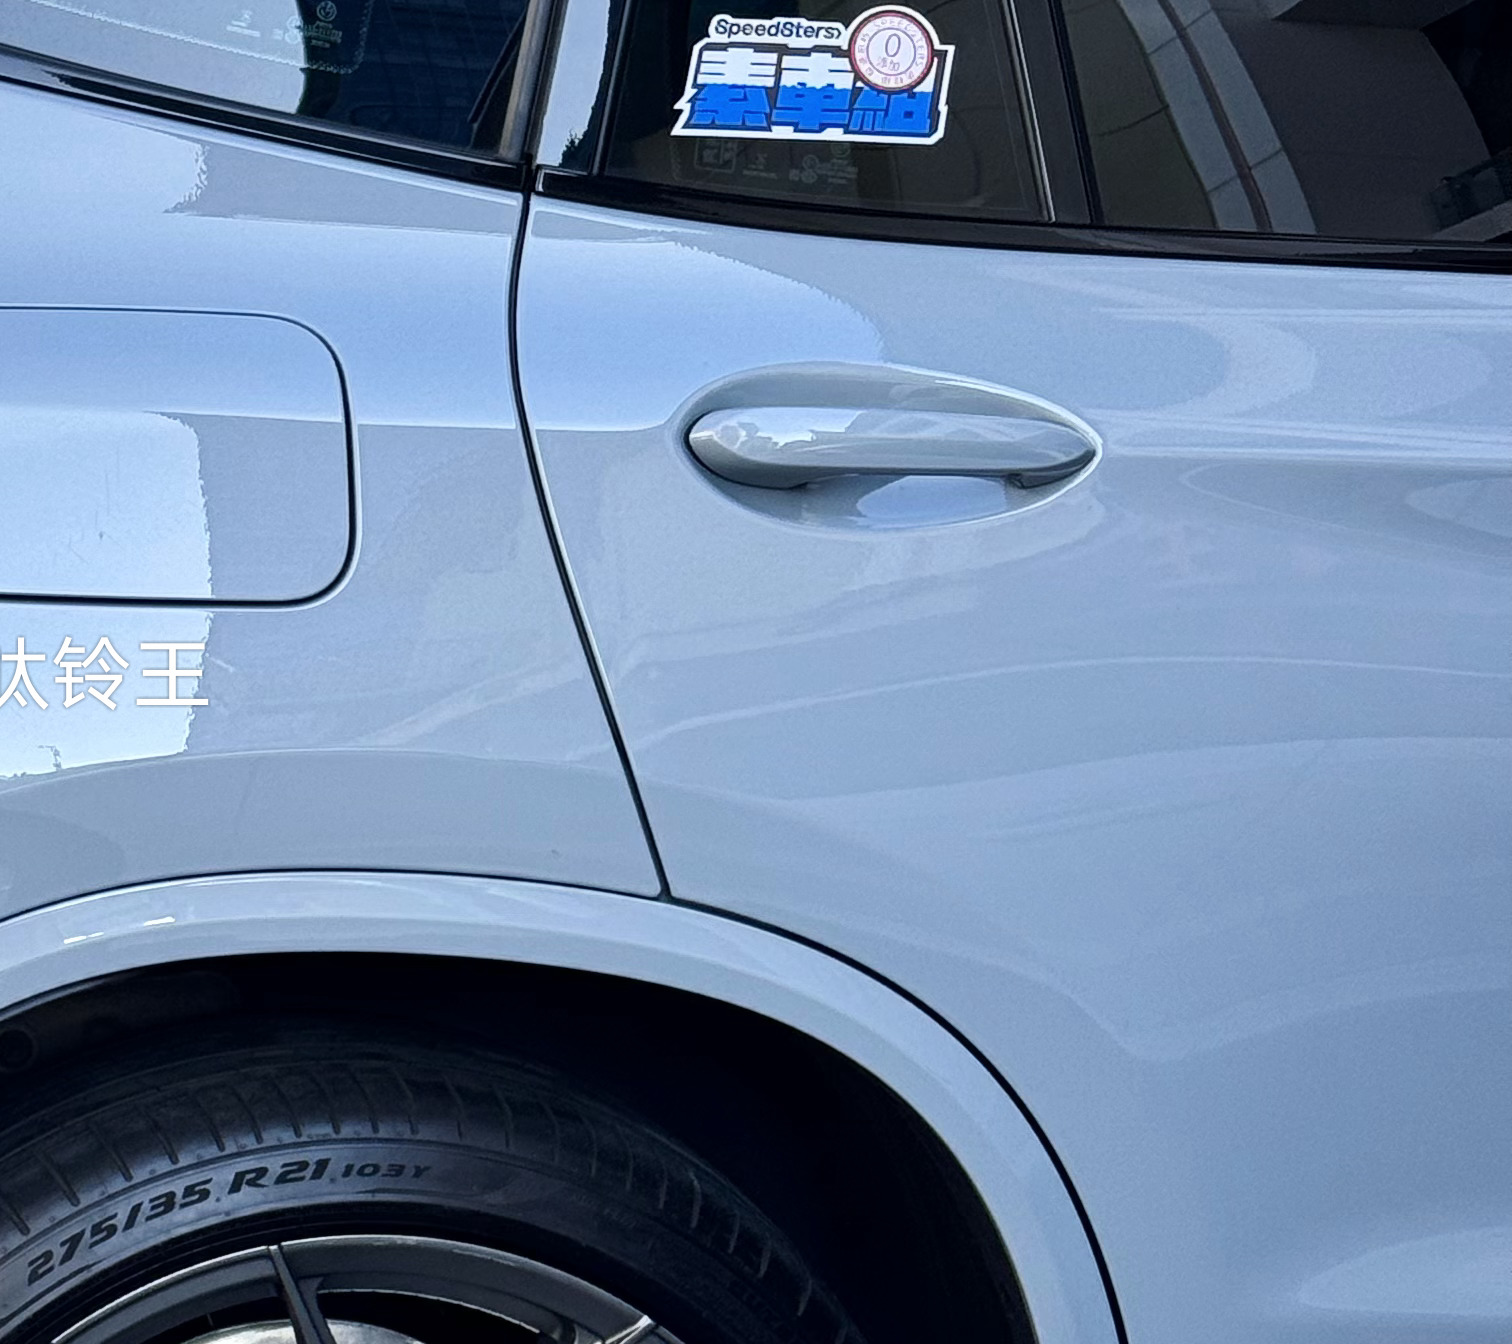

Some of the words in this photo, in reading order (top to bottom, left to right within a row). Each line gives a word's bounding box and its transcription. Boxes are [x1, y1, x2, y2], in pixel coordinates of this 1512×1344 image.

[27, 1177, 214, 1287] 275/35
[227, 1157, 332, 1196] R21
[341, 1160, 433, 1181] 103Y
